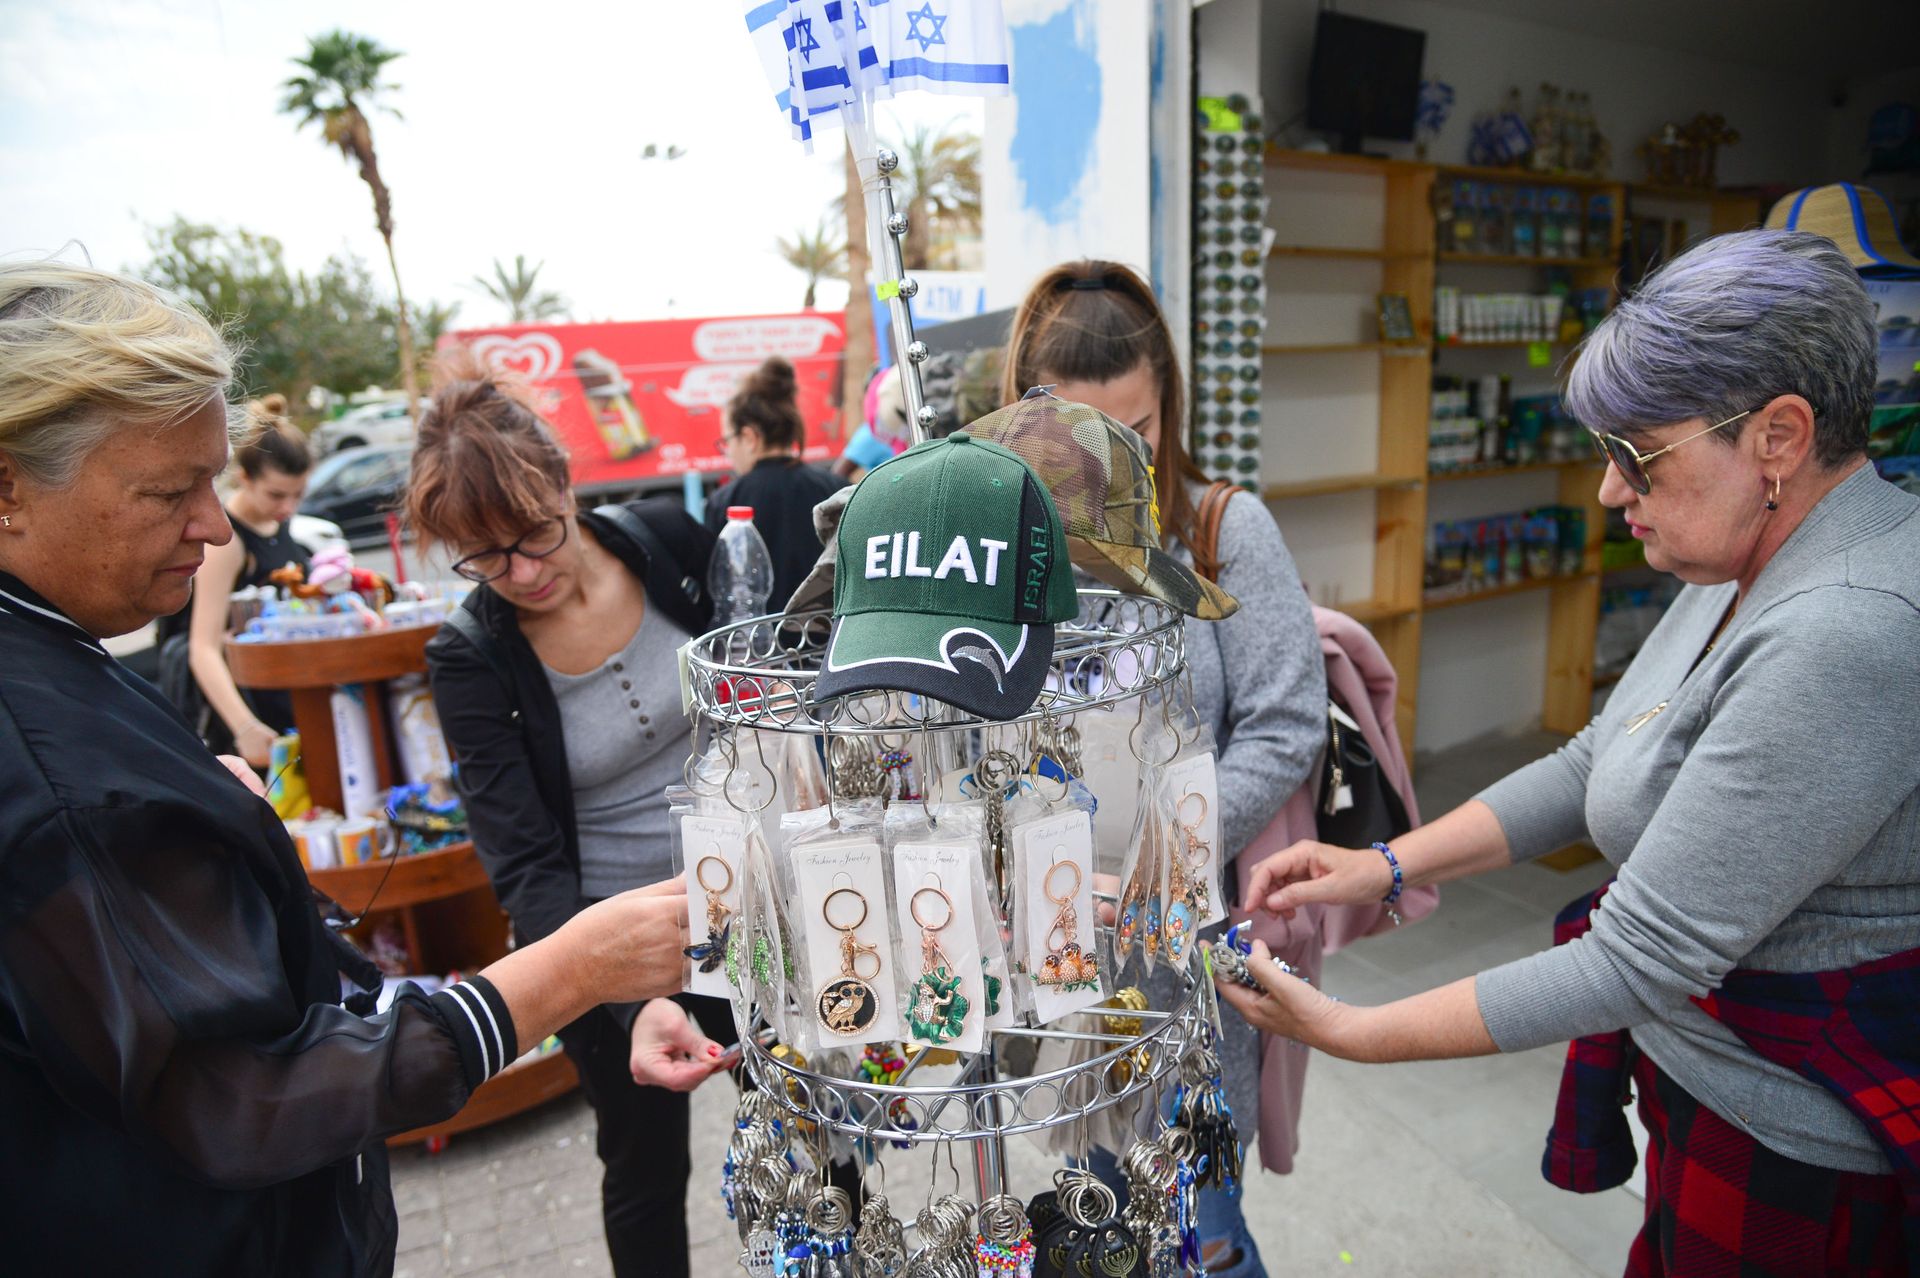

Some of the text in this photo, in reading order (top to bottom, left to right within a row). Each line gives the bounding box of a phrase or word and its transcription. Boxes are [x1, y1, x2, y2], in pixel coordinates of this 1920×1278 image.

[925, 287, 963, 311] ATM
[865, 531, 1008, 586] EILAT
[1023, 526, 1049, 609] ISRAEL
[807, 850, 871, 865] Fashion Jewelry
